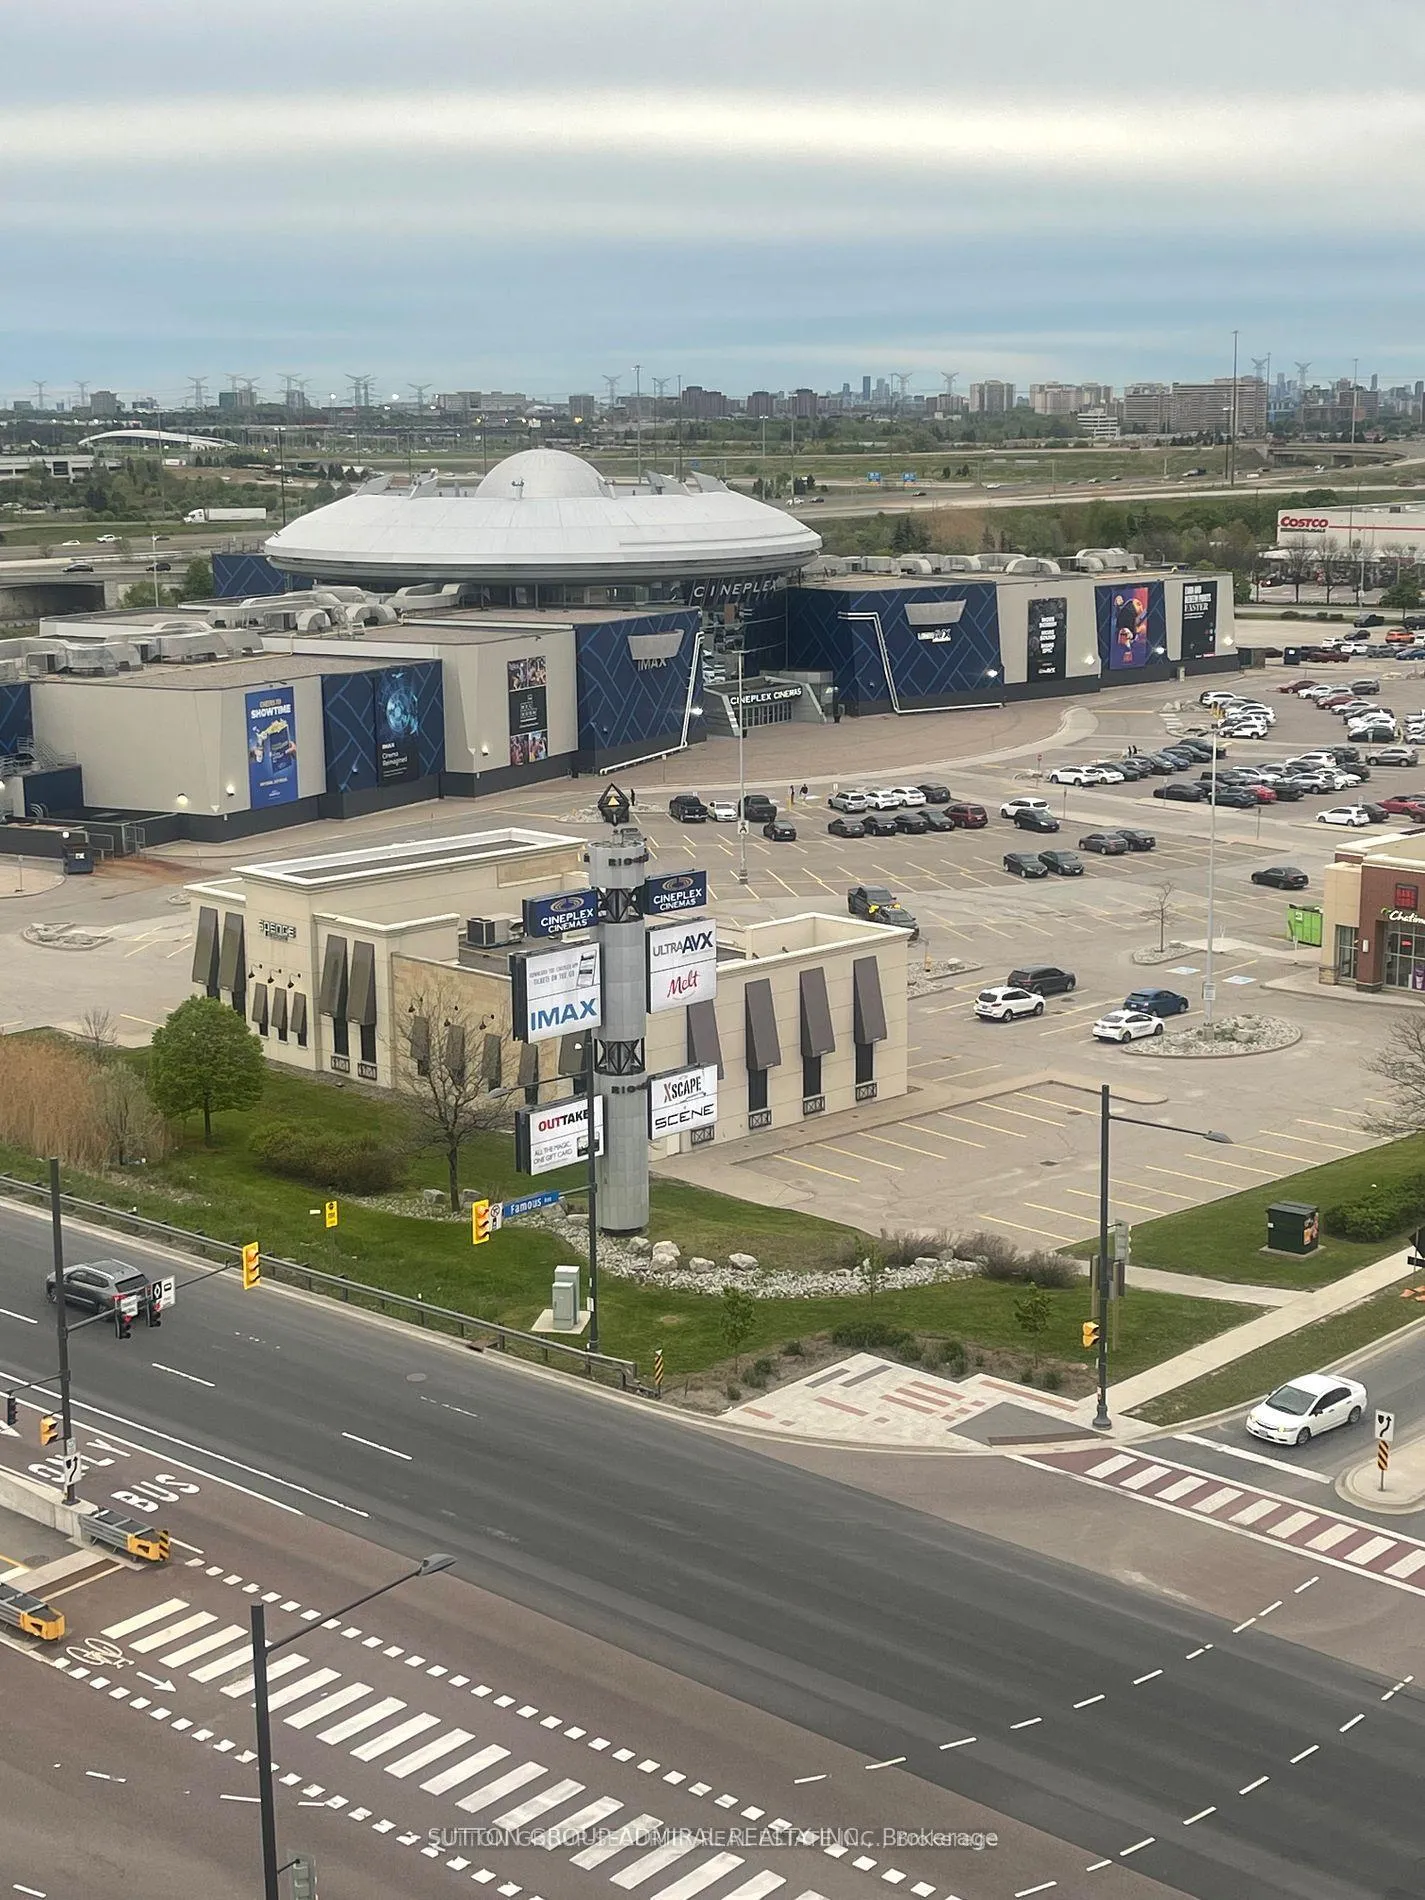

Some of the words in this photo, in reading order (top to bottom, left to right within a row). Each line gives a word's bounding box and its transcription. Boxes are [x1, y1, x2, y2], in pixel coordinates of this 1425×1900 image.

[1281, 516, 1328, 527] COSTCO
[638, 658, 667, 671] IMAX
[730, 693, 771, 705] CINEPLEX
[251, 704, 291, 719] SHOWTIME
[653, 888, 702, 904] CINEPLEX
[660, 898, 696, 910] CINEMAS
[541, 908, 594, 927] CINEPLEX
[548, 918, 588, 933] CINEMAS
[667, 970, 701, 998] Melt
[531, 997, 597, 1031] IMAX
[663, 1076, 702, 1103] XSCAPE
[655, 1103, 714, 1130] SCENE
[110, 1473, 200, 1512] BUS
